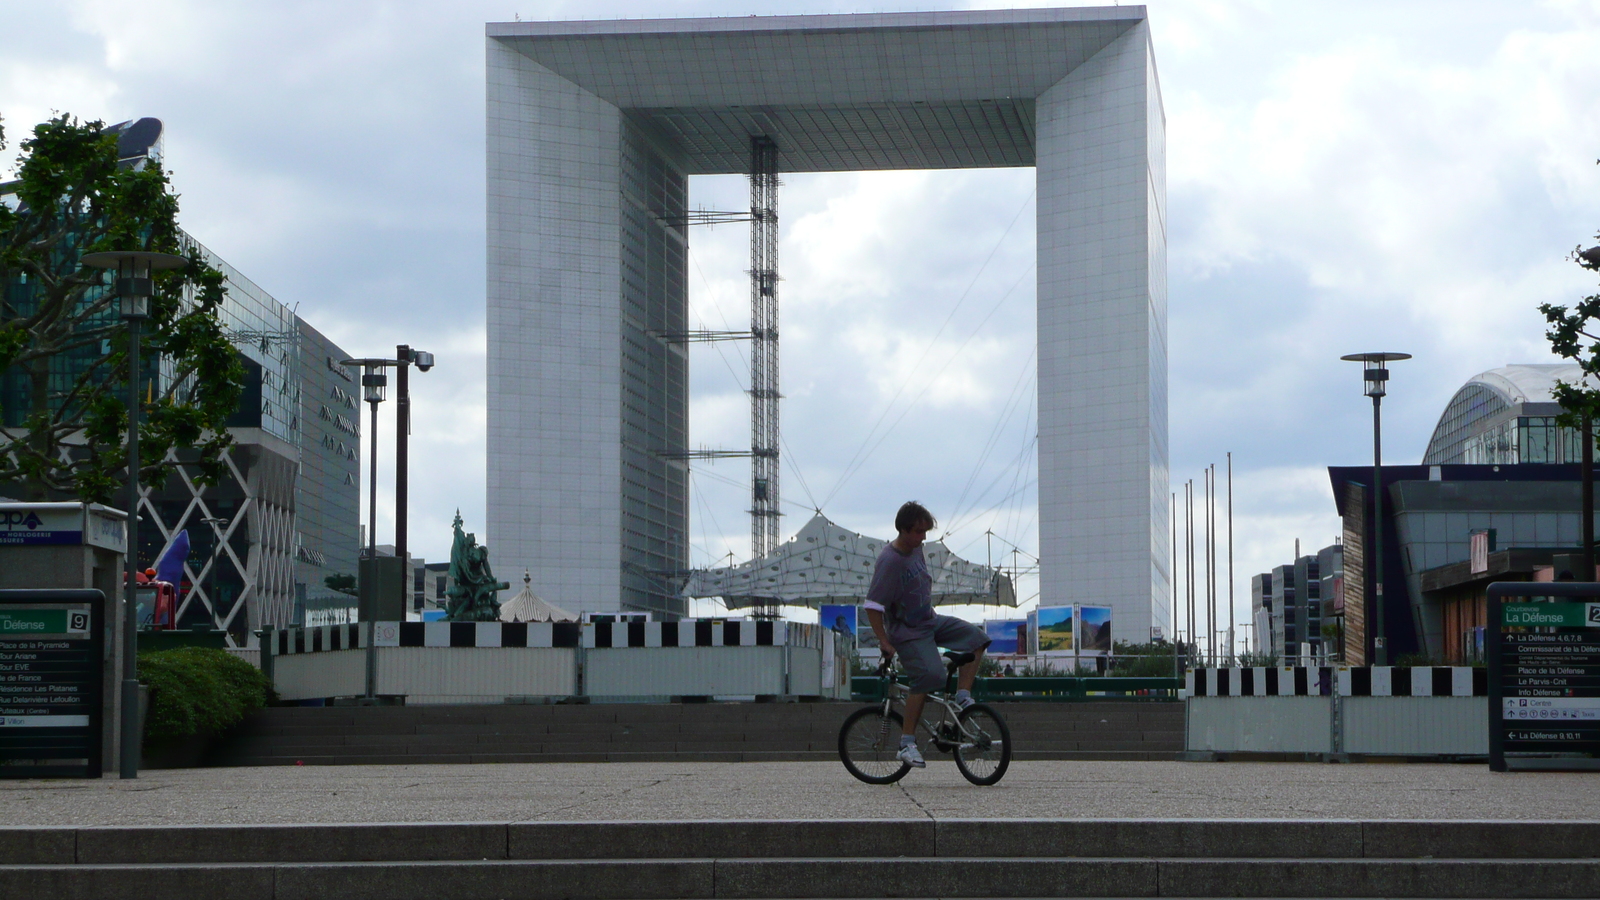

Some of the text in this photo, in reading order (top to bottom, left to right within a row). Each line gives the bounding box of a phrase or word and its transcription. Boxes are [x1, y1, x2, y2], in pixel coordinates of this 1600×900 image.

[74, 615, 84, 628] 9
[1506, 612, 1563, 622] La Défense
[4, 619, 45, 630] Défense
[38, 642, 70, 650] Pyramide
